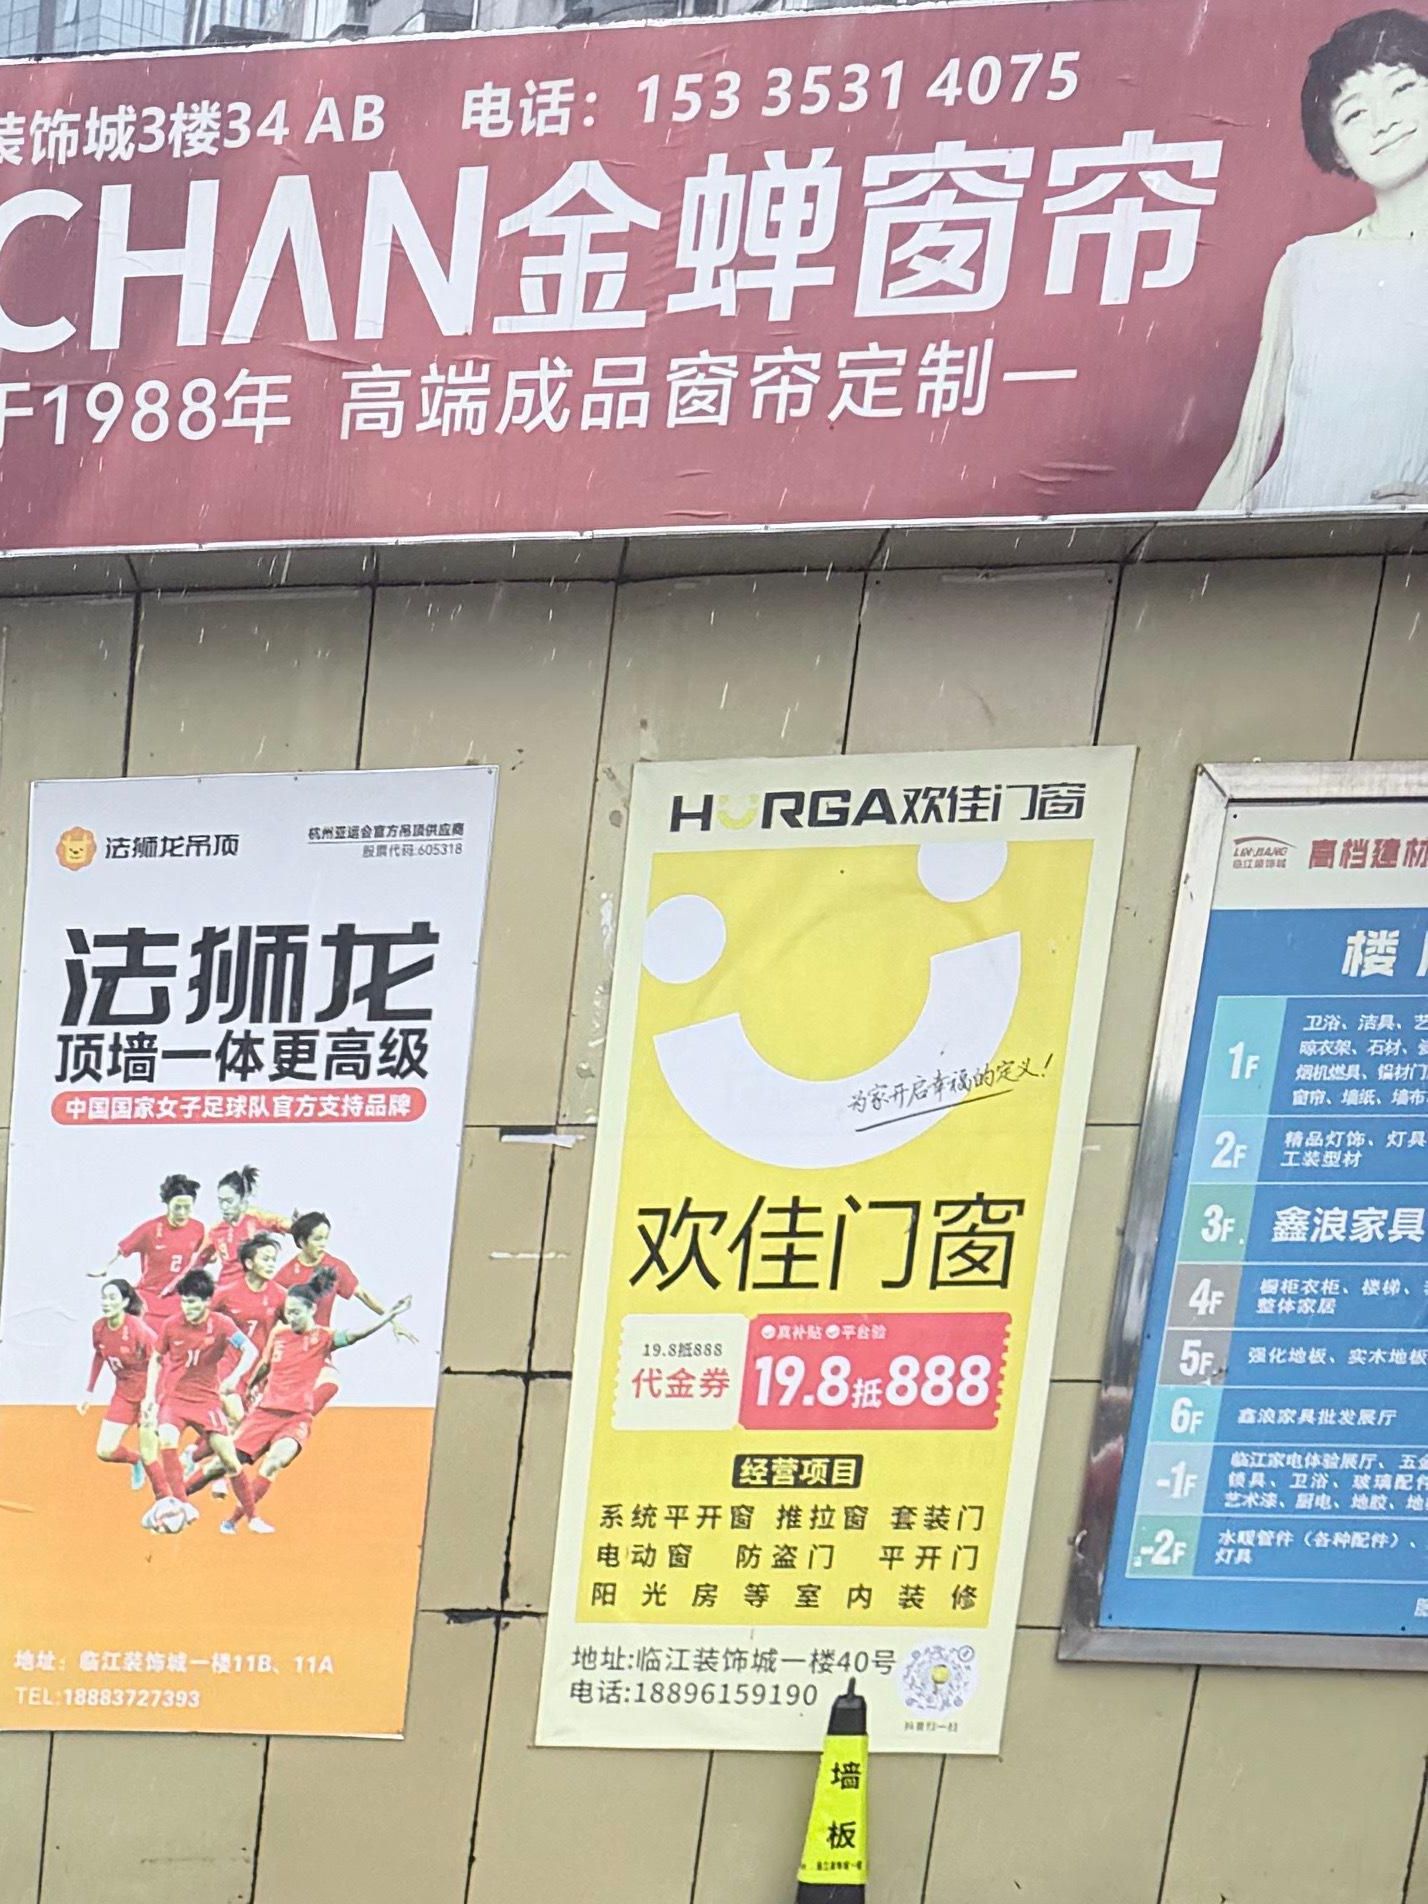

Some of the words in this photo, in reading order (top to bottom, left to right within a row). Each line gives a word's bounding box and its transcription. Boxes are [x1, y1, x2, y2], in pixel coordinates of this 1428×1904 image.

[306, 95, 385, 144] AB
[762, 59, 903, 117] 3531
[928, 51, 1081, 106] 4075
[105, 833, 239, 858] 法狮龙吊顶
[60, 921, 440, 1026] 法狮龙
[54, 1027, 429, 1084] 顶墙一体更高级
[1228, 1042, 1260, 1080] 1F
[65, 1092, 411, 1121] 中国国家女子足球队官方支持品牌
[1211, 1131, 1248, 1168] 2F
[1280, 1151, 1362, 1168] 工装型材
[1201, 1204, 1235, 1242] 3F
[1271, 1206, 1425, 1243] 鑫浪家具
[629, 1192, 1025, 1292] 欢佳门窗
[1188, 1279, 1225, 1316] 4F
[642, 1343, 723, 1358] 19.8抵888
[1179, 1340, 1214, 1376] 5F
[632, 1367, 730, 1400] 代金券
[754, 1354, 993, 1409] 19.8抵888
[1170, 1398, 1204, 1434] 6F
[1237, 1408, 1398, 1426] 鑫浪家具批发展厅
[740, 1457, 859, 1487] 经营项目
[1156, 1461, 1198, 1498] -1F
[599, 1503, 754, 1531] 系统平开窗
[776, 1503, 869, 1531] 推拉窗
[891, 1504, 984, 1531] 套装门
[597, 1543, 692, 1569] 电动窗
[736, 1543, 835, 1570] 防盗门
[879, 1544, 978, 1571] 平开门
[1215, 1548, 1252, 1565] 灯具
